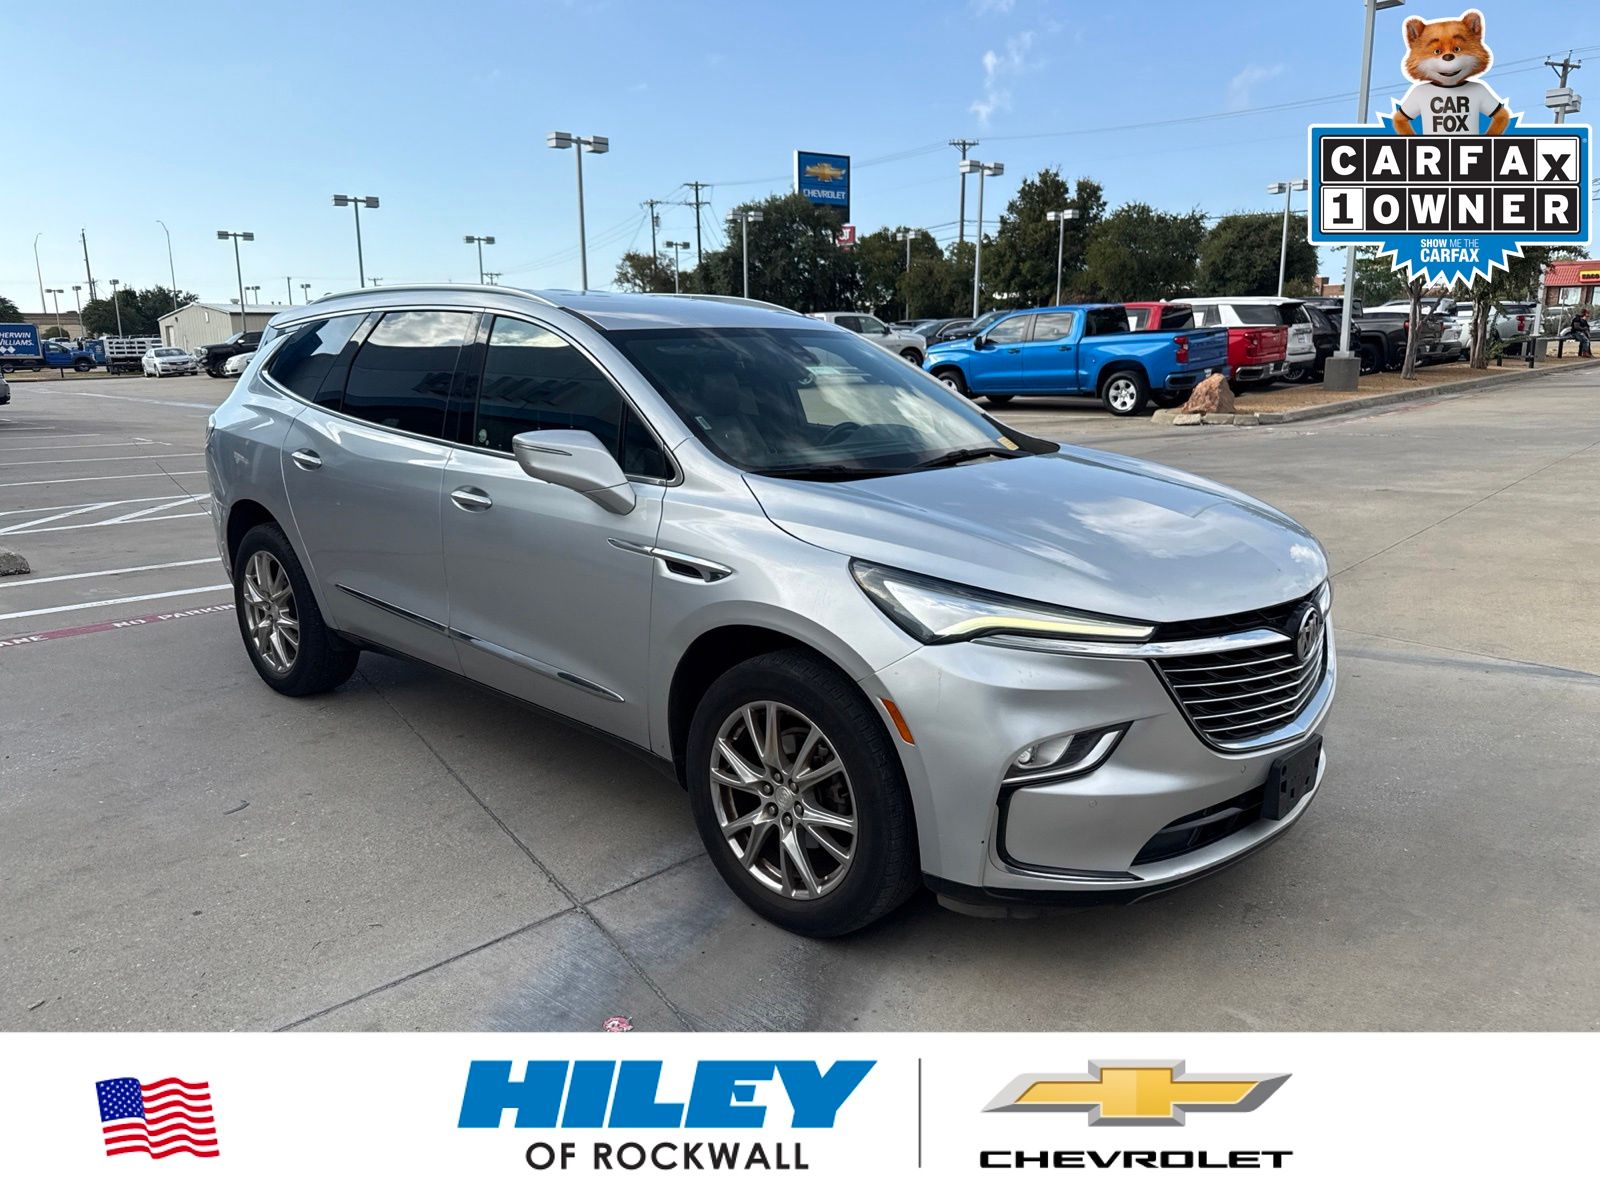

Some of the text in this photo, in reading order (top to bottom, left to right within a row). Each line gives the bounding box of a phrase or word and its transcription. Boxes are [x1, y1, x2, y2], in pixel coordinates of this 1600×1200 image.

[803, 188, 847, 200] CHEVROLET
[0, 331, 32, 339] HERWIN
[0, 603, 237, 648] ANE NO PARKIN
